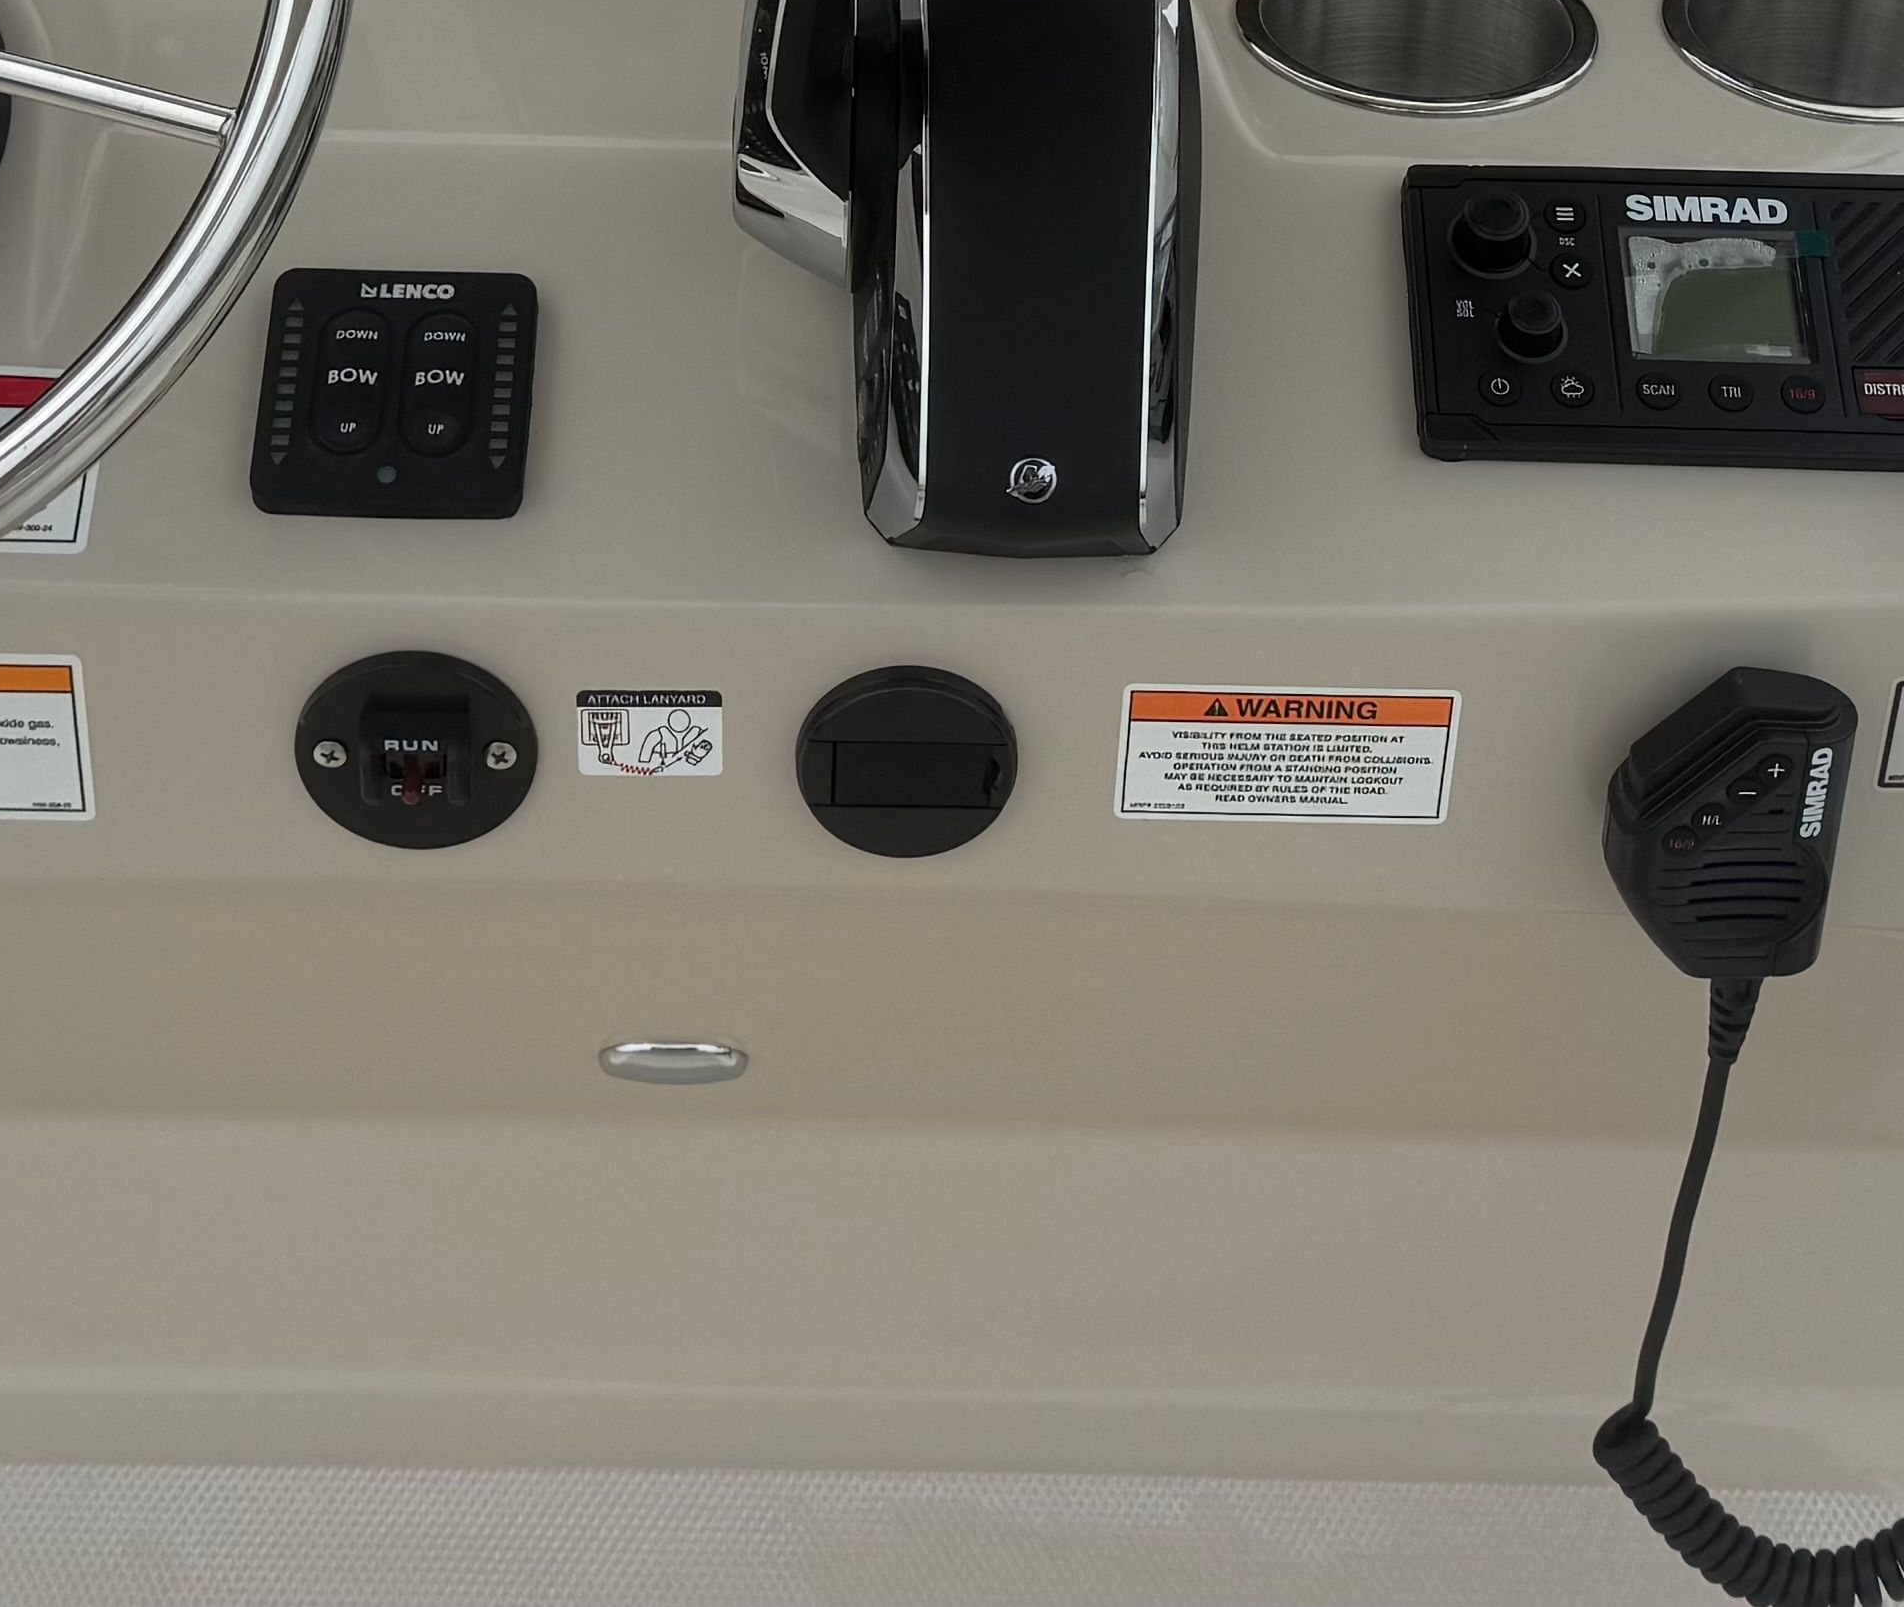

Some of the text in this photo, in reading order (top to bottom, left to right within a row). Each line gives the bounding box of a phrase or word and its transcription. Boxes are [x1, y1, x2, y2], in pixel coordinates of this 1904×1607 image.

[1625, 194, 1788, 224] SIMRAD
[379, 283, 455, 300] LENCO
[336, 329, 378, 340] DOWN
[423, 331, 466, 343] DOWN
[327, 368, 378, 386] BOW
[414, 369, 465, 386] BOW
[1642, 383, 1675, 396] SCAN
[1721, 386, 1741, 399] TRI
[340, 422, 356, 434] UP
[427, 424, 444, 436] UP
[587, 694, 706, 705] ATTACH LANYARD
[1237, 698, 1378, 720] WARNING
[1172, 731, 1405, 743] VISIBILITY FROM THE SEATED POSITION AT
[384, 739, 438, 751] RUN
[391, 784, 443, 796] OF
[1799, 747, 1834, 838] SIMRAD
[1215, 794, 1245, 803] READ
[1247, 795, 1296, 804] OWNERS
